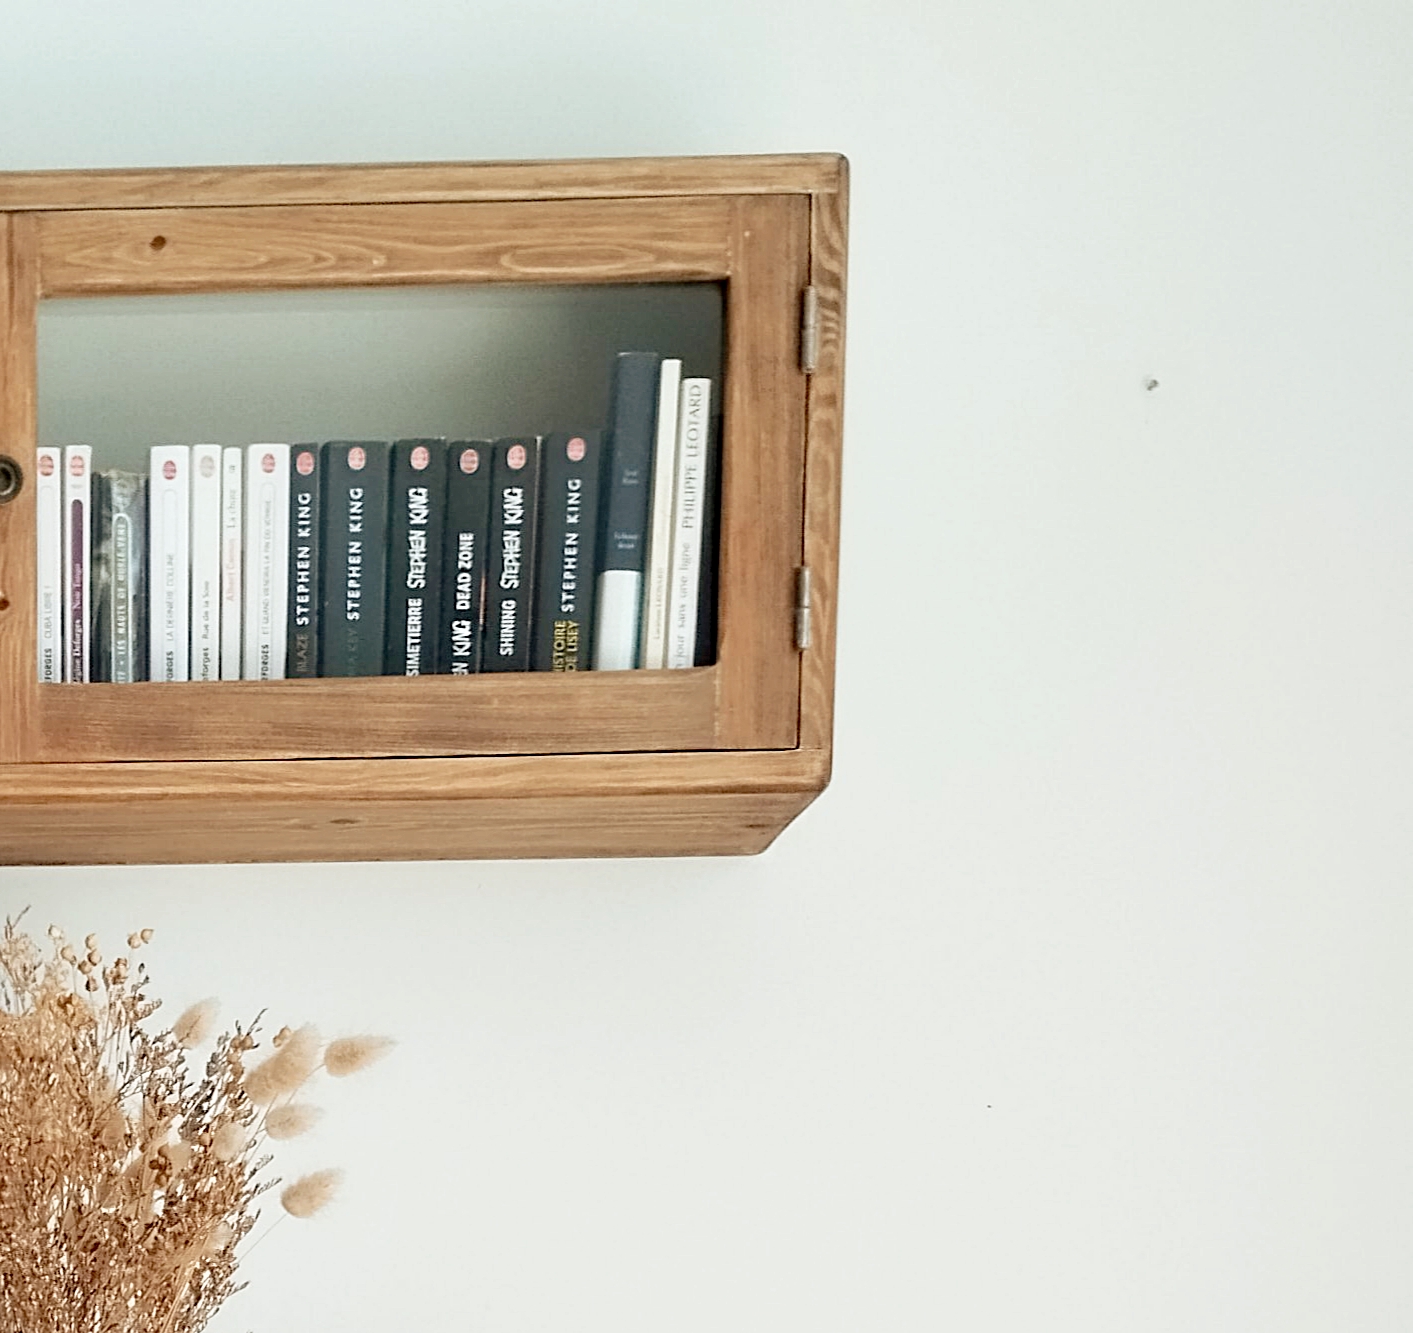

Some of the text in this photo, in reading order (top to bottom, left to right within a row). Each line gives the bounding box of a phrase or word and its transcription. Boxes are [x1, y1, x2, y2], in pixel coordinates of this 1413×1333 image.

[349, 488, 363, 532] KING
[680, 465, 697, 529] PHILIPPE
[457, 532, 474, 569] ZONE
[499, 487, 524, 656] SHINING STEPHEN KING
[561, 479, 582, 613] STEPHEN KING
[296, 493, 311, 671] BLAZE STEPHEN KING
[347, 541, 362, 621] STEPHEN
[406, 487, 429, 676] SIMETIERRE STEPHEN KING
[455, 573, 472, 610] DEAD
[451, 620, 472, 656] KING
[567, 620, 579, 652] LISEY
